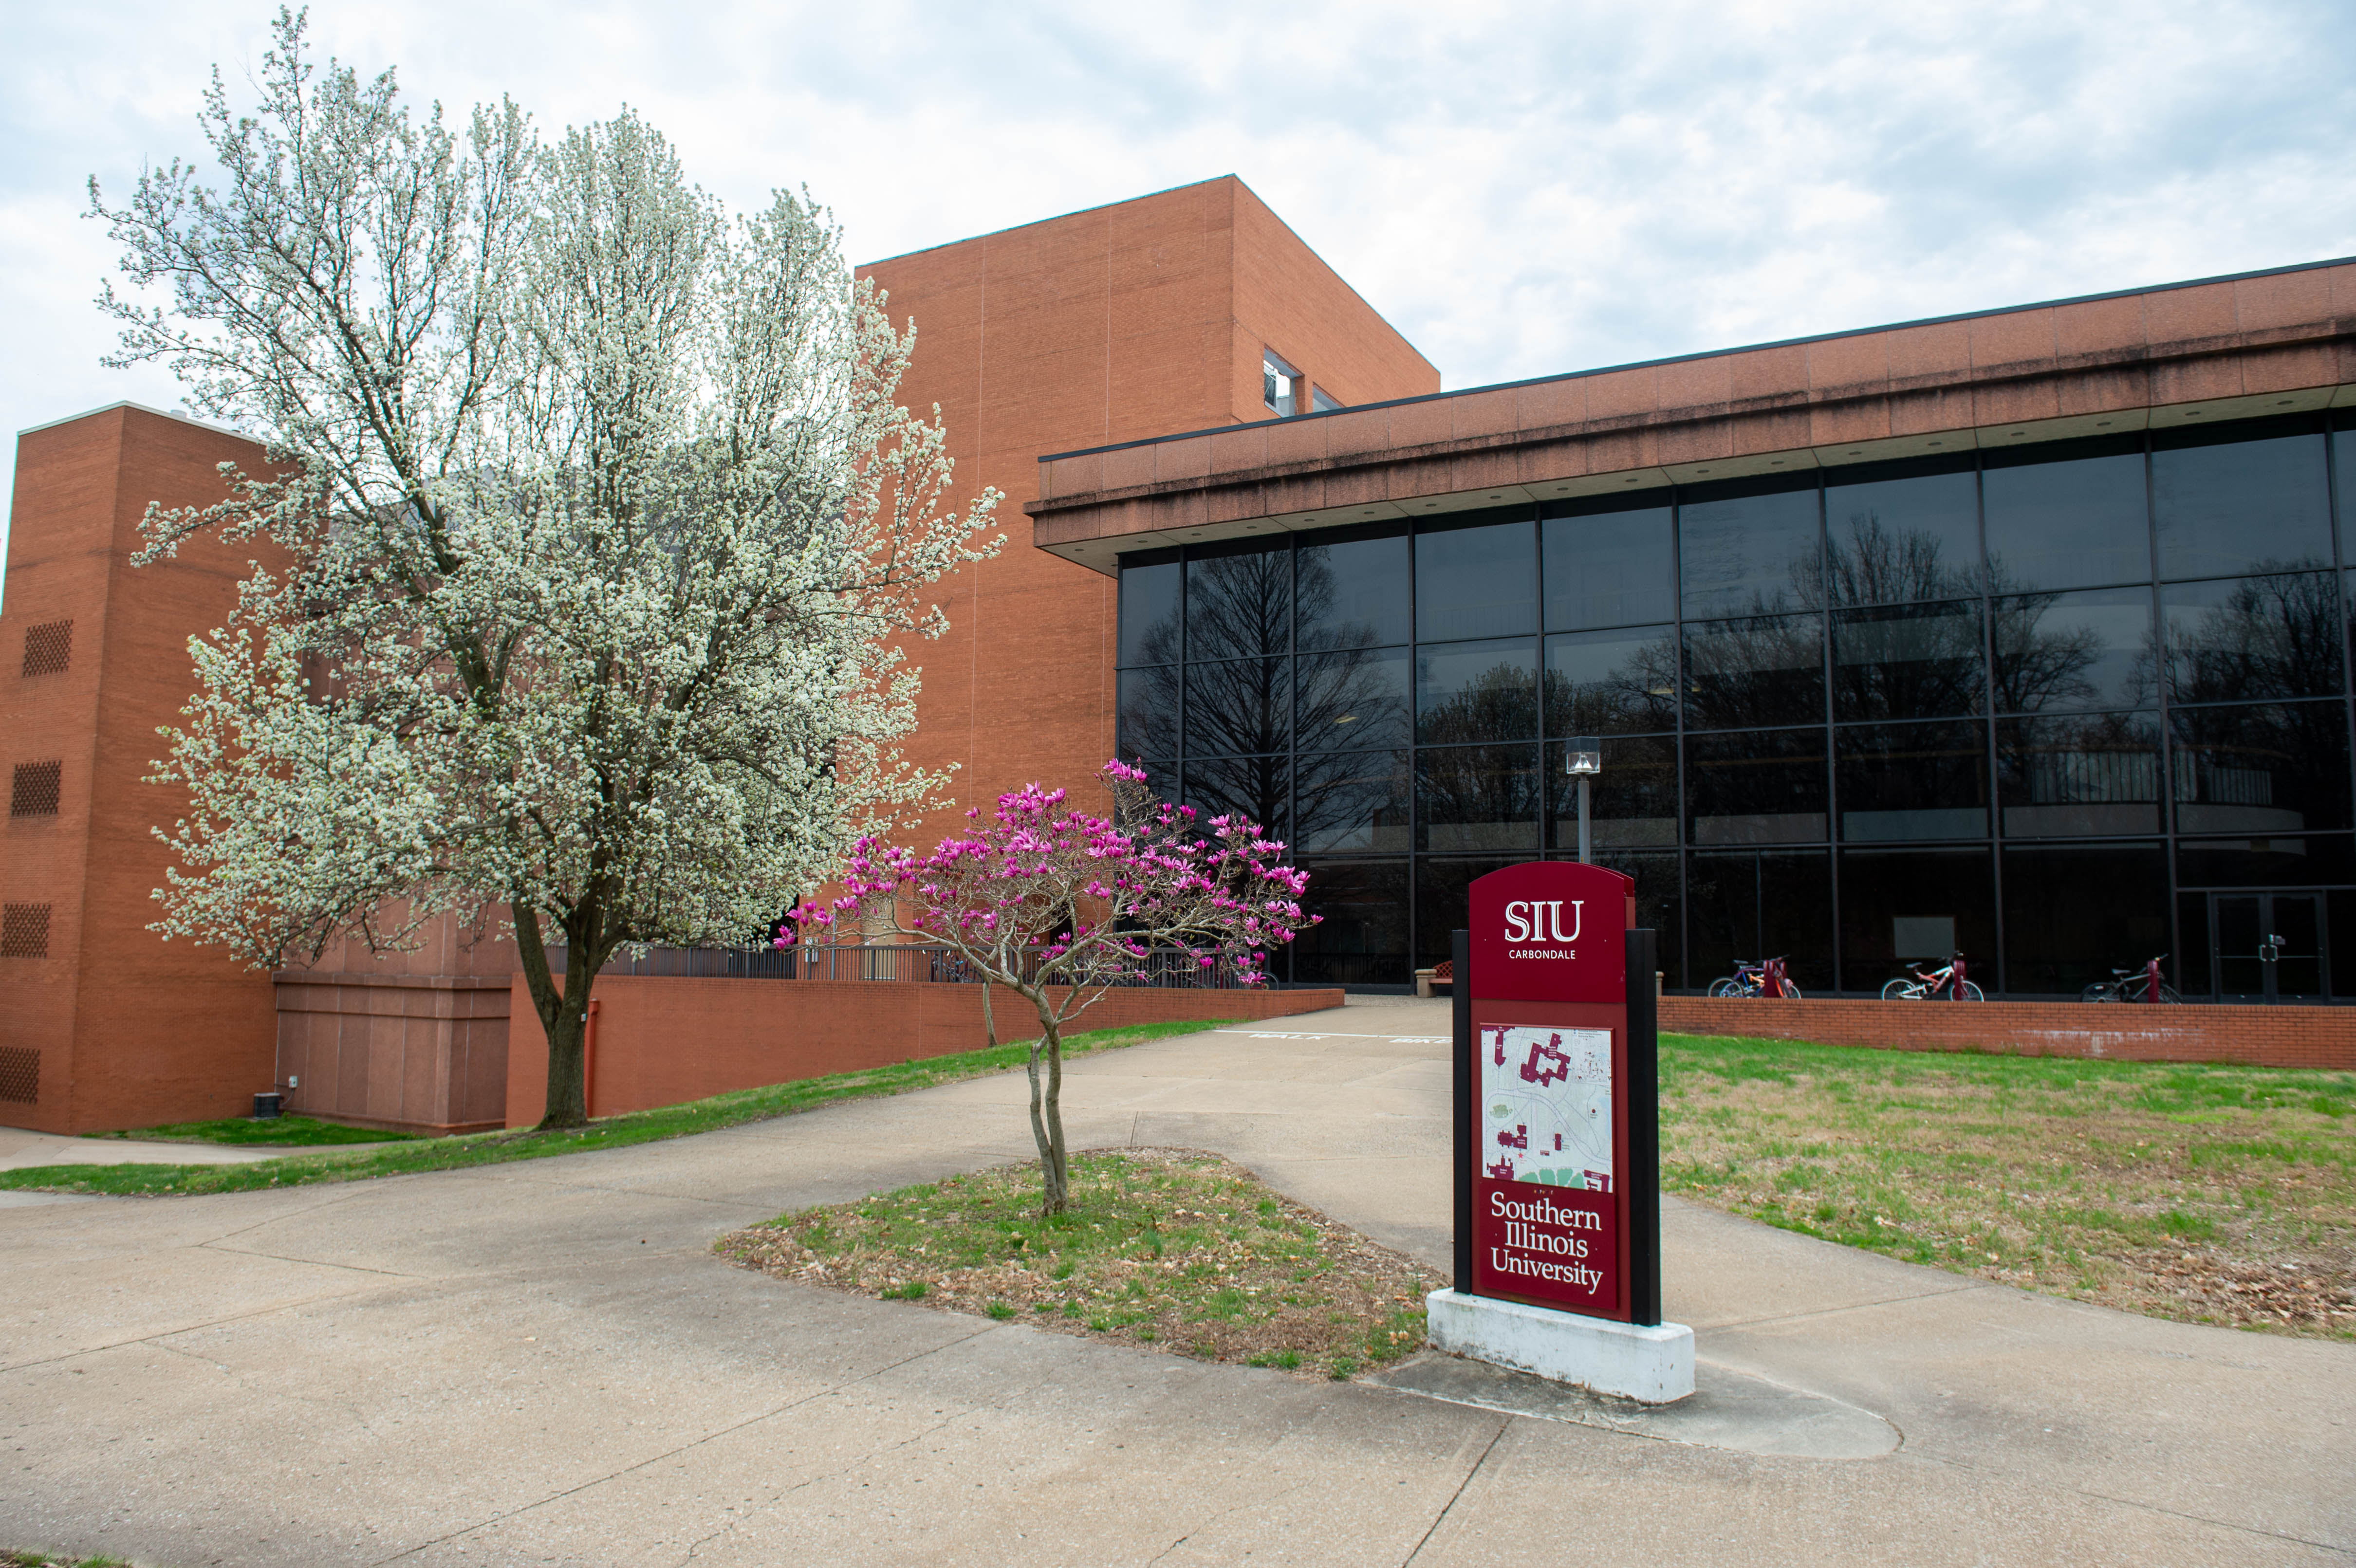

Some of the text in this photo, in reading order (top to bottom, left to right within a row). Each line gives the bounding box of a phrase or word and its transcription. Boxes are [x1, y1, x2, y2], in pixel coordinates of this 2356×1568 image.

[1504, 900, 1584, 942] SIU
[1509, 950, 1576, 959] CARBONDALE
[1491, 1191, 1602, 1231] Southern
[1504, 1220, 1589, 1258] Illinois
[1490, 1246, 1604, 1295] University
